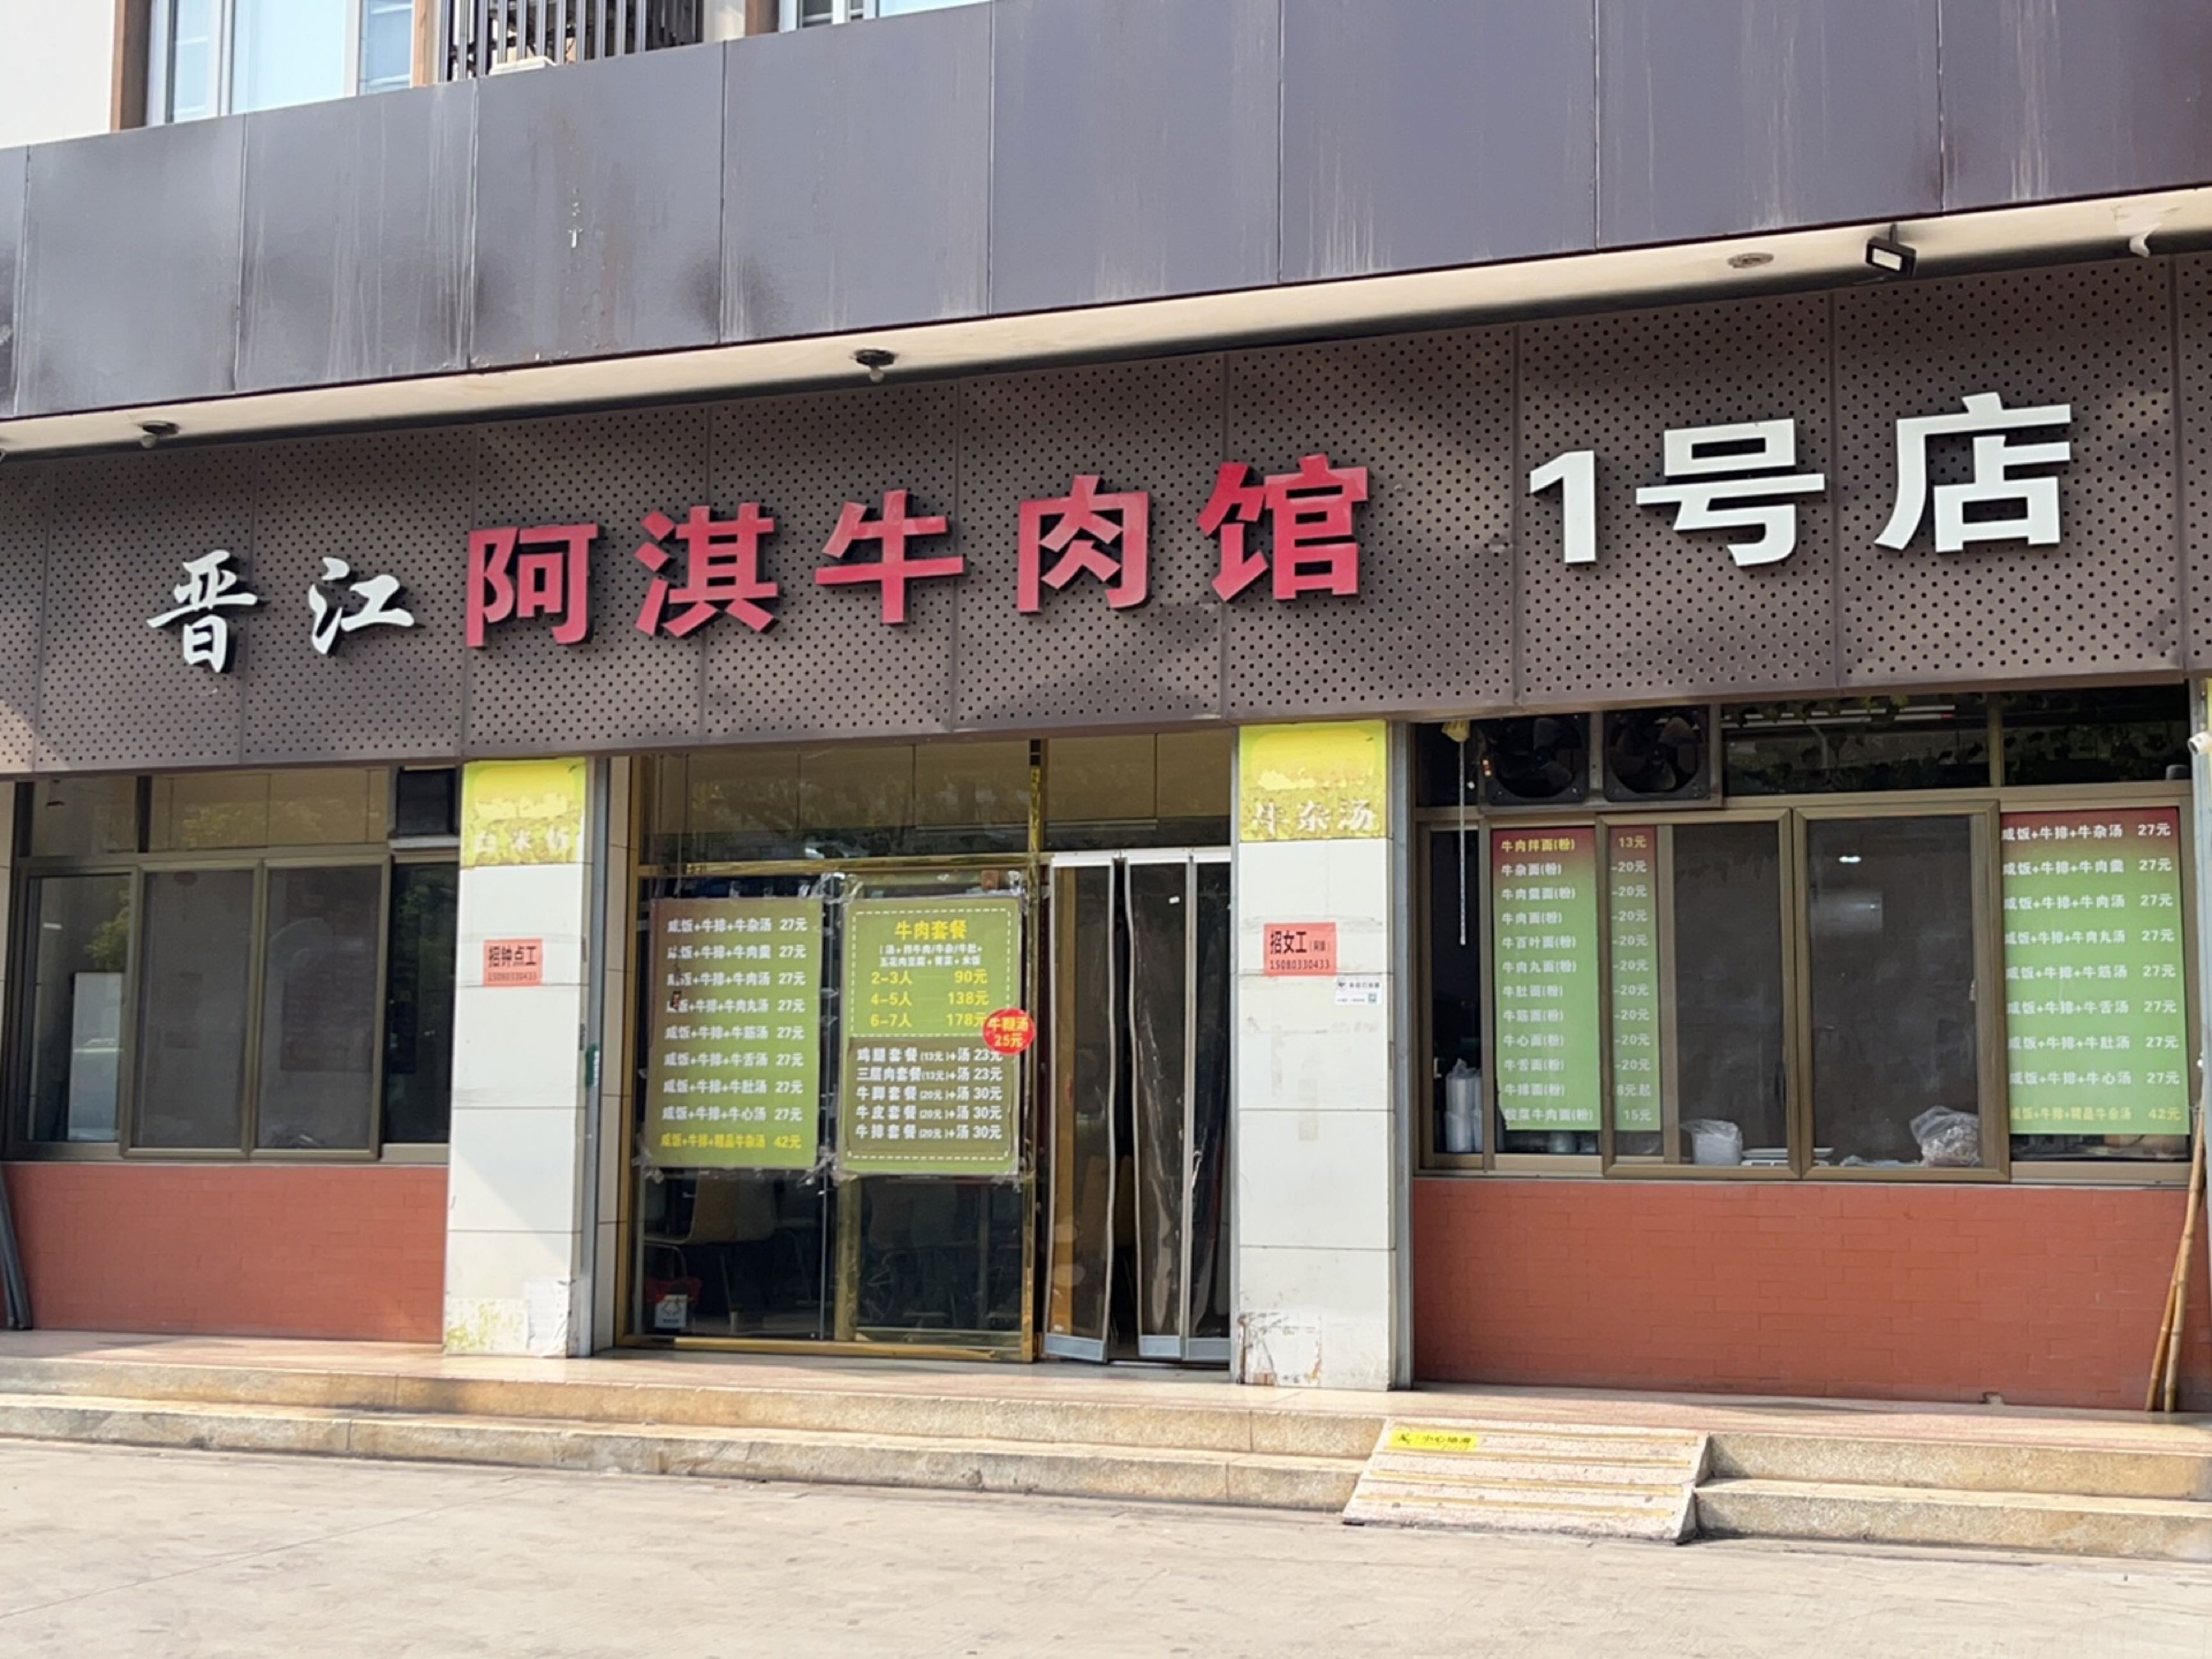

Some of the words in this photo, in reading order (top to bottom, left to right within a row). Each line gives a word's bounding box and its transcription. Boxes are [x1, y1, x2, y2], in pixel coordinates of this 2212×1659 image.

[145, 549, 416, 675] 晋江
[467, 454, 1369, 648] 阿淇牛肉馆
[1529, 390, 2073, 568] 1号店
[2138, 822, 2171, 836] 27元
[1618, 836, 1647, 849] 13元
[2139, 858, 2172, 872] 27元
[2140, 894, 2173, 907] 27元
[780, 917, 807, 931] 27元
[894, 920, 968, 940] 牛肉套餐
[1270, 930, 1307, 954] 招女工
[2141, 929, 2175, 942] 27元
[779, 945, 806, 958] 27元
[871, 971, 913, 984] 2-3人
[954, 968, 988, 983] 90元
[2143, 965, 2176, 977] 27元
[778, 972, 806, 986] 27元
[778, 998, 805, 1013] 27元
[870, 993, 912, 1007] 4-5人
[948, 991, 990, 1006] 138元
[2144, 1000, 2176, 1013] 27元
[870, 1014, 912, 1028] 6-7人
[946, 1013, 987, 1028] 178元
[777, 1026, 805, 1039] 27元
[994, 1033, 1023, 1048] 25元
[2145, 1036, 2179, 1048] 27元
[776, 1053, 803, 1066] 27元
[973, 1049, 1003, 1062] 23元
[973, 1067, 1003, 1082] 23元
[2147, 1071, 2180, 1085] 27元
[775, 1080, 803, 1093] 27元
[973, 1086, 1003, 1101] 30元
[774, 1107, 803, 1121] 27元
[973, 1105, 1002, 1120] 30元
[1624, 1110, 1651, 1121] 15元
[2148, 1107, 2181, 1121] 42元
[972, 1125, 1002, 1139] 30元
[774, 1135, 801, 1149] 42元
